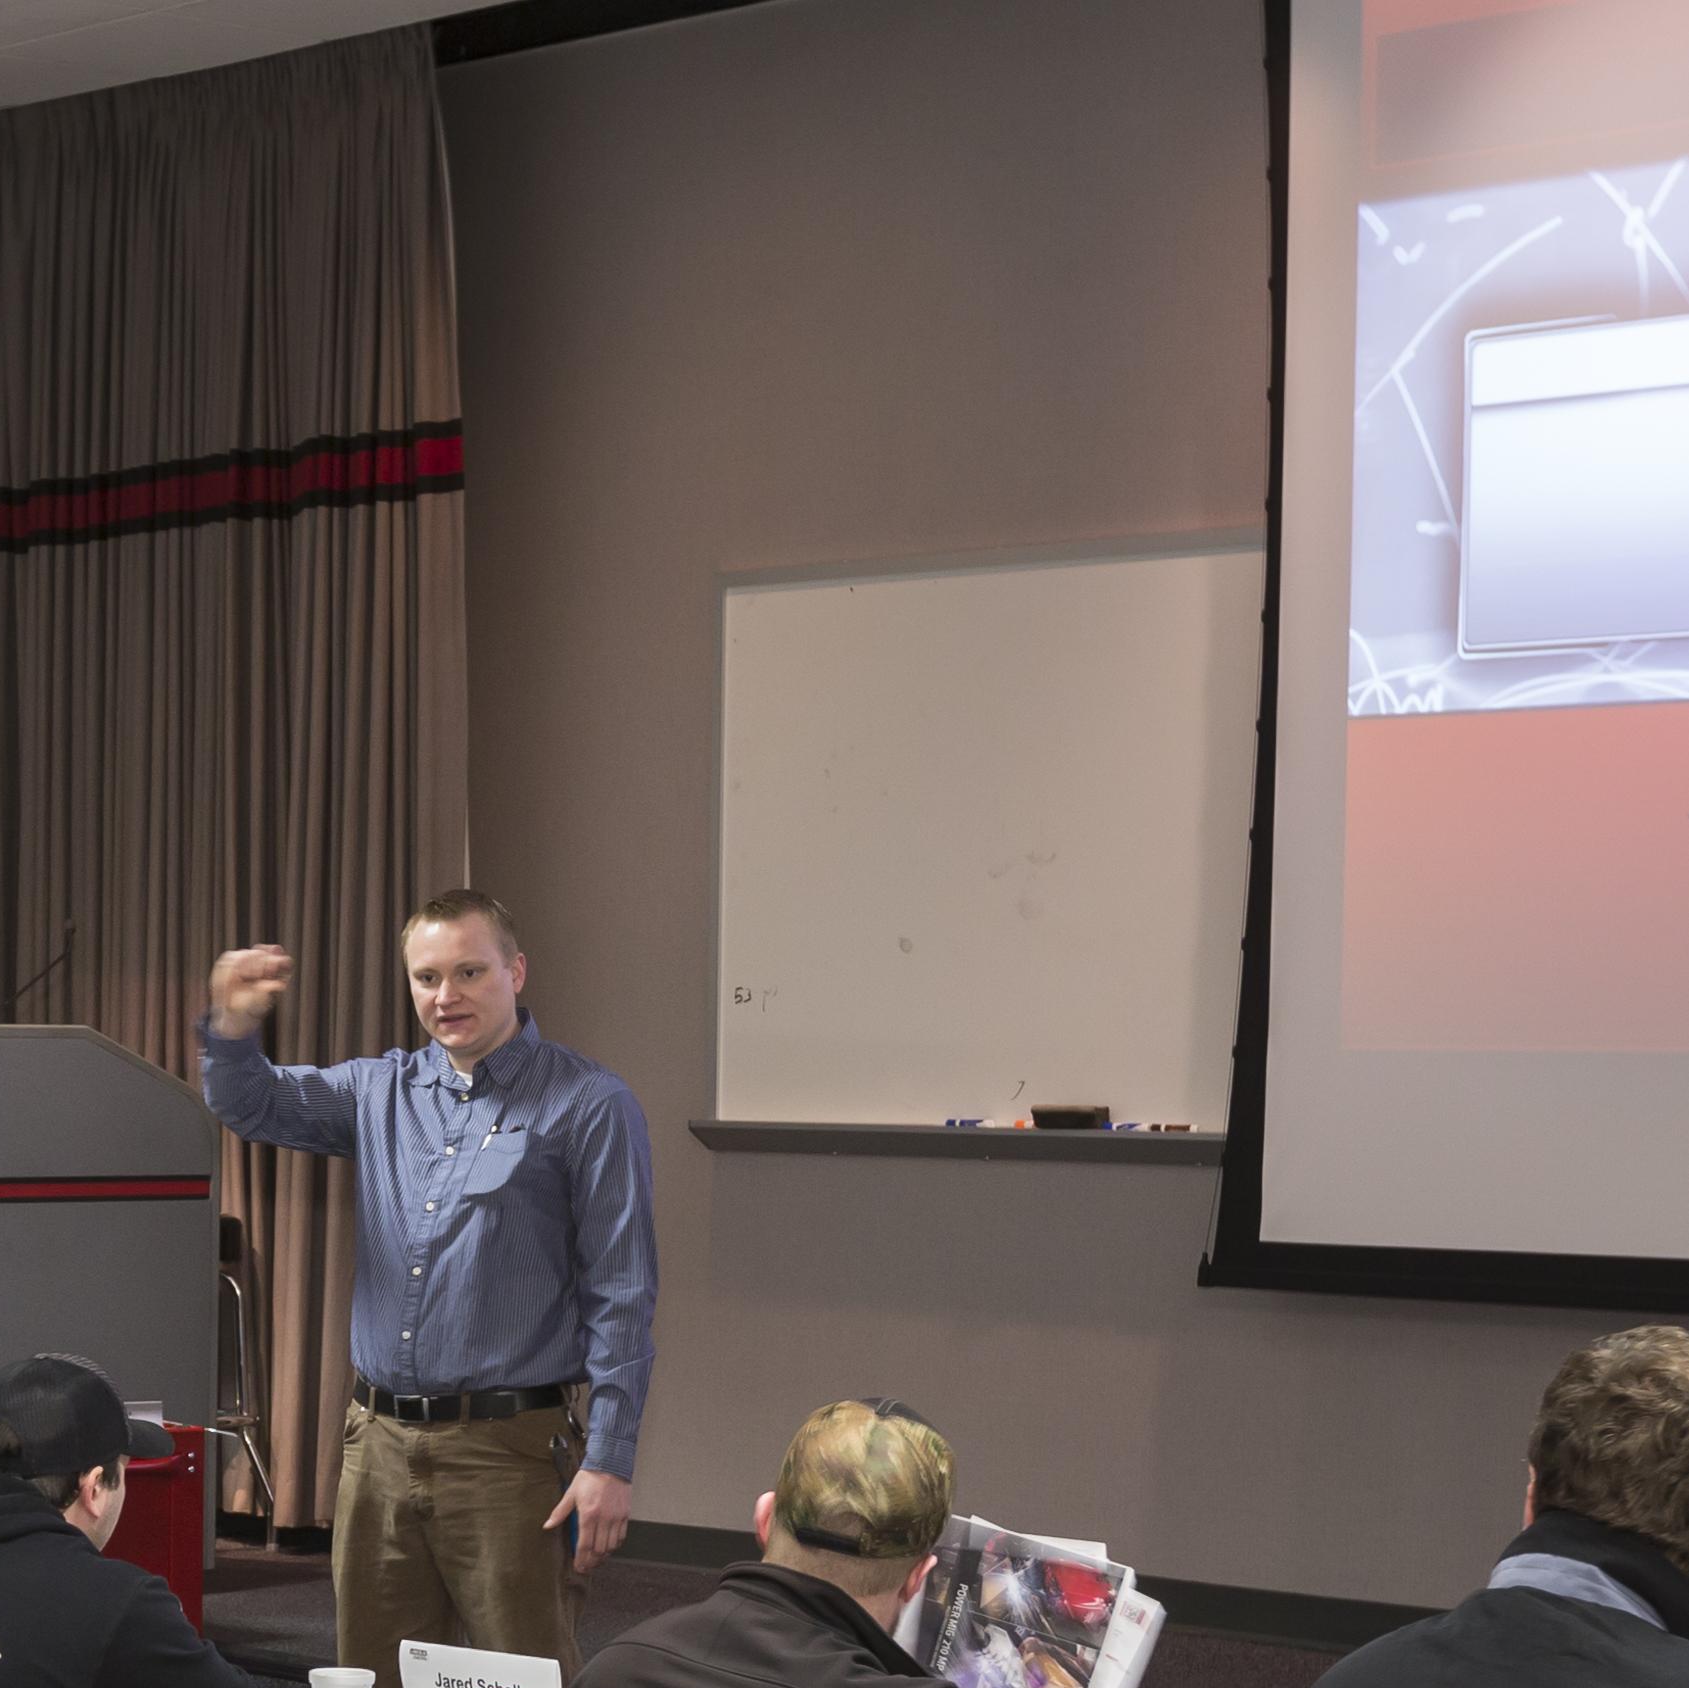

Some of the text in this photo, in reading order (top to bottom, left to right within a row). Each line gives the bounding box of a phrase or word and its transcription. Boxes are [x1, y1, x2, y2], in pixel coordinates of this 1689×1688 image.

[951, 1583, 969, 1619] POWER
[945, 1618, 958, 1637] MIG
[940, 1639, 951, 1655] 210
